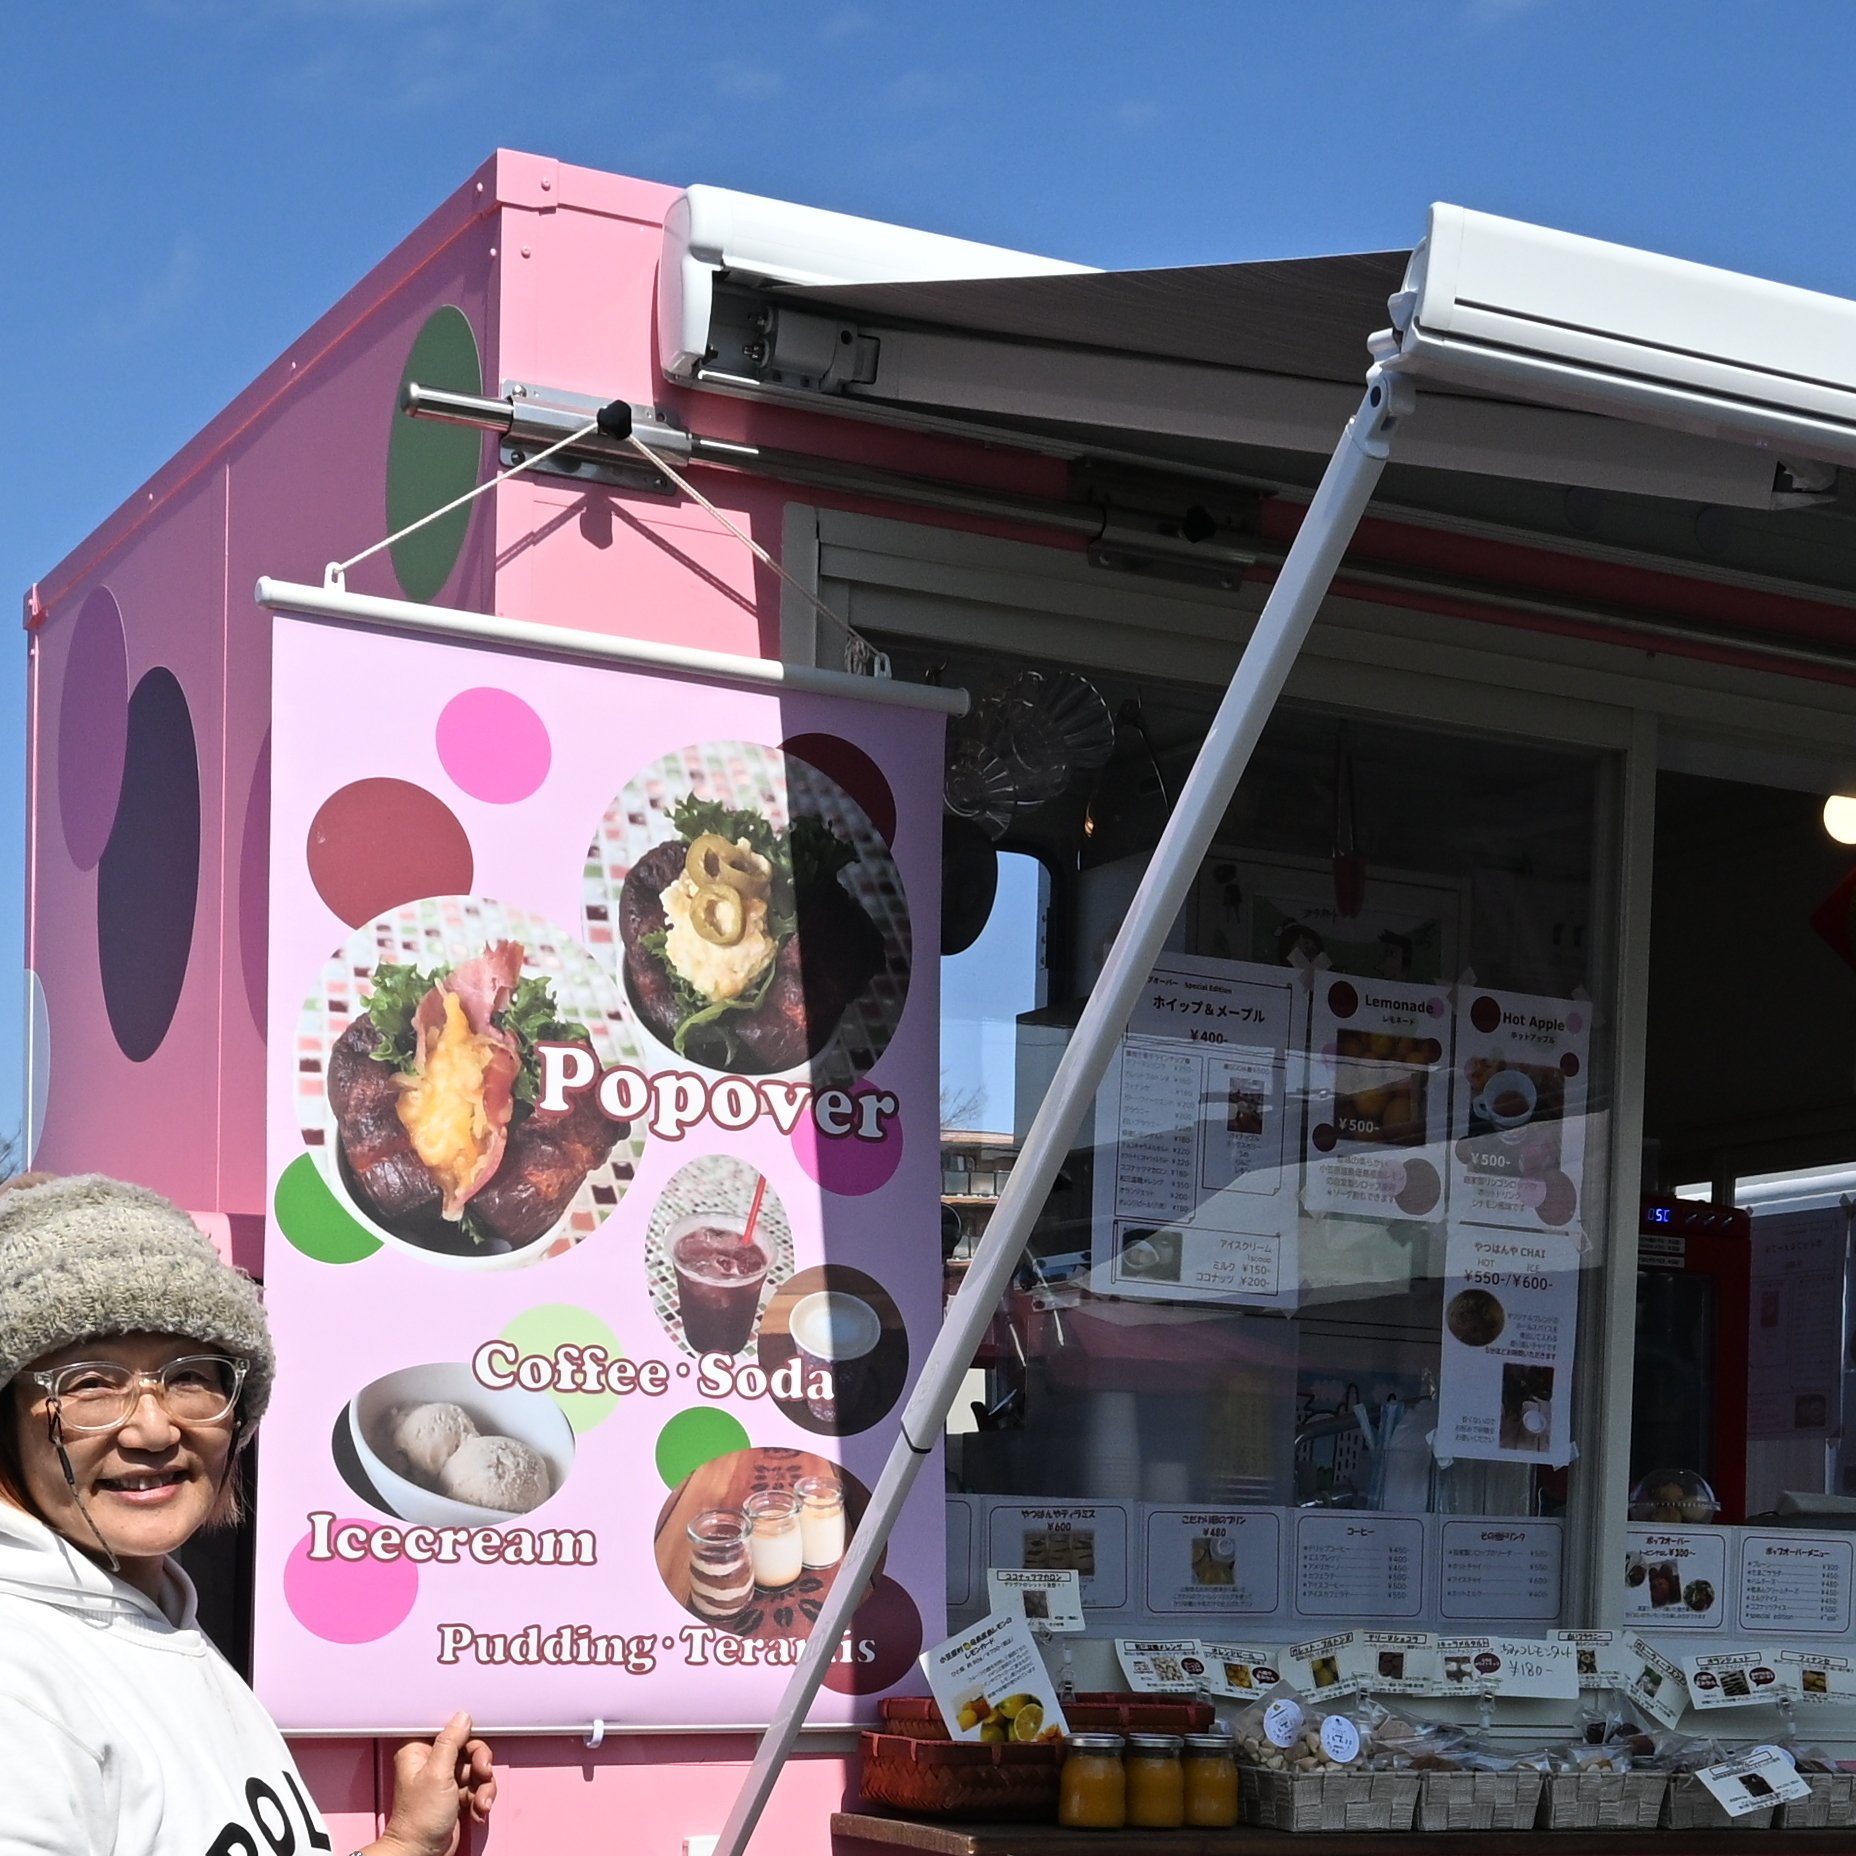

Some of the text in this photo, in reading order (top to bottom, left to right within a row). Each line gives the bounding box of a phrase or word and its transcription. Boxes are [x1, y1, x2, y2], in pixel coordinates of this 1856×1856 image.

[1184, 981, 1208, 993] Special
[1209, 984, 1232, 995] Edition
[1365, 994, 1435, 1015] Lemonade
[1502, 1011, 1566, 1032] Hot Apple
[1190, 1028, 1229, 1045] ¥400-
[1511, 1031, 1555, 1044] ホットアップル
[535, 1041, 900, 1141] Popover
[1338, 1117, 1381, 1134] ¥500-
[1470, 1152, 1511, 1168] ¥500-
[1219, 1239, 1272, 1253] アイスクリーム
[1473, 1241, 1546, 1259] やつはんや CHAI
[1212, 1261, 1235, 1272] ミルク
[1477, 1258, 1541, 1273] HOT ICE
[1195, 1272, 1235, 1285] ココナッツ
[471, 1340, 836, 1402] Coffee Soda
[307, 1511, 598, 1565] Icecream
[1347, 1527, 1375, 1536] コーヒー
[437, 1623, 657, 1674] Pudding
[1508, 1660, 1553, 1677] ¥180-
